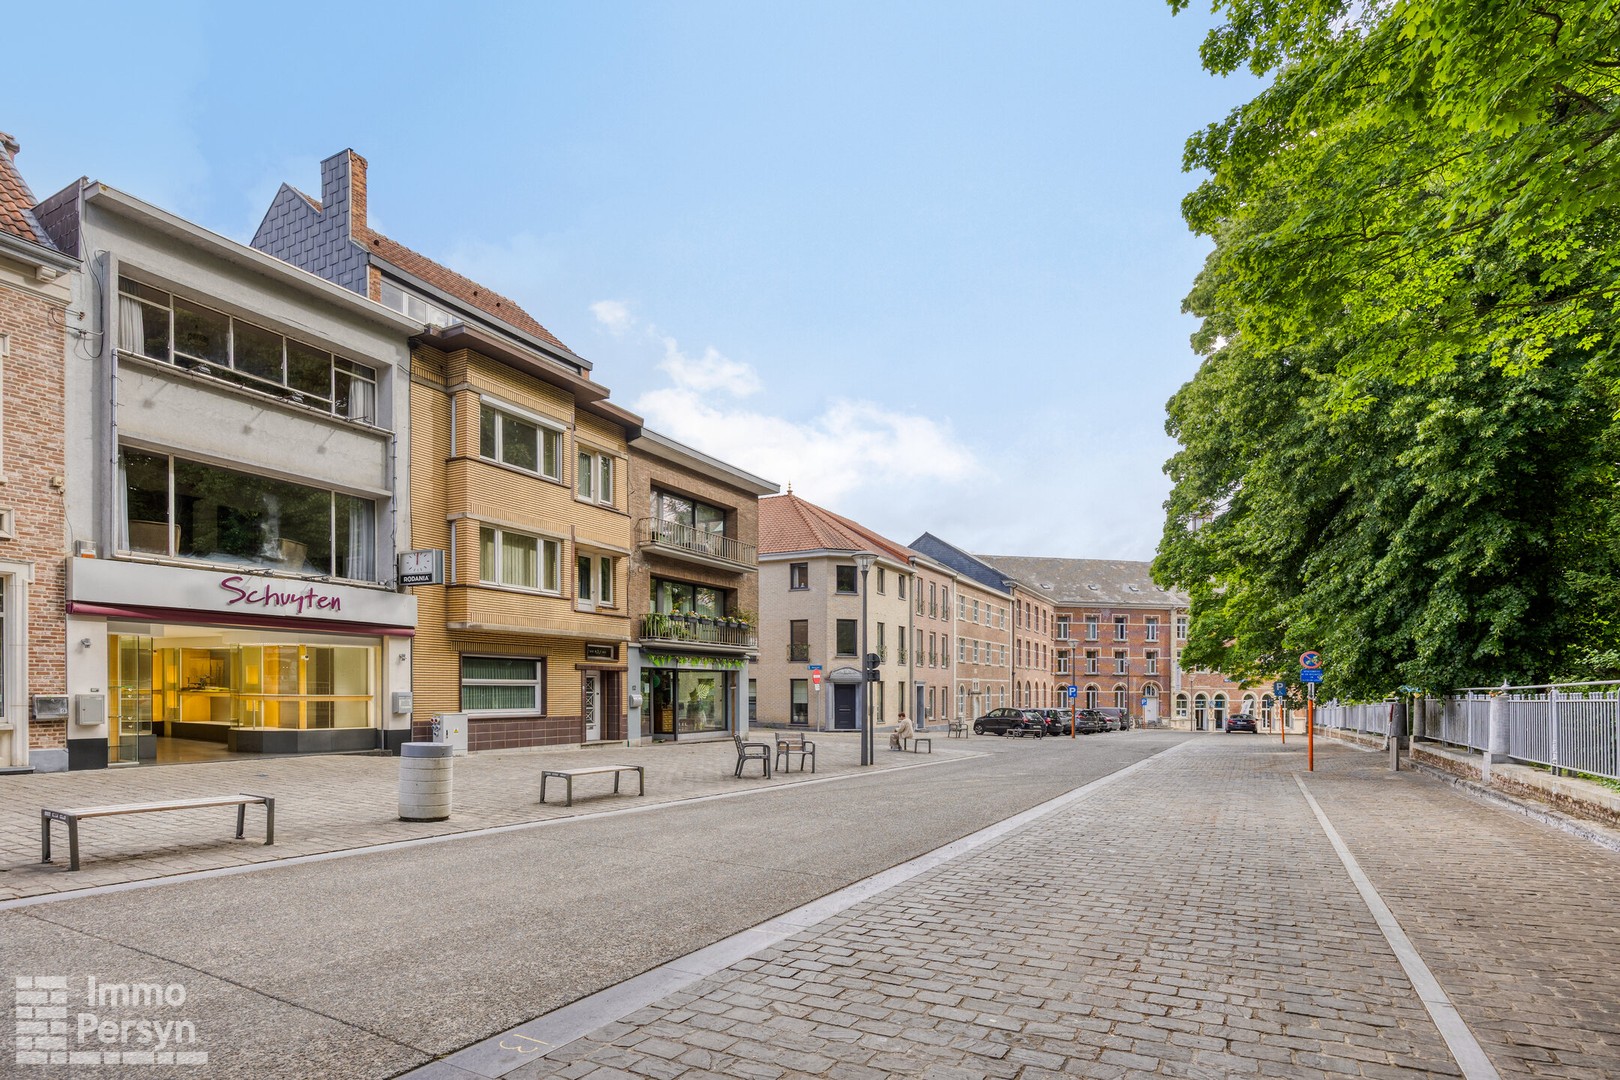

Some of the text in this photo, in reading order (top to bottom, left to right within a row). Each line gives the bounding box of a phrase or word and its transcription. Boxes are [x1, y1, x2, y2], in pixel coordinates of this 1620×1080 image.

[403, 575, 430, 583] RODANIA
[220, 576, 341, 614] Schuyten
[1276, 682, 1284, 691] P
[1069, 687, 1076, 697] P
